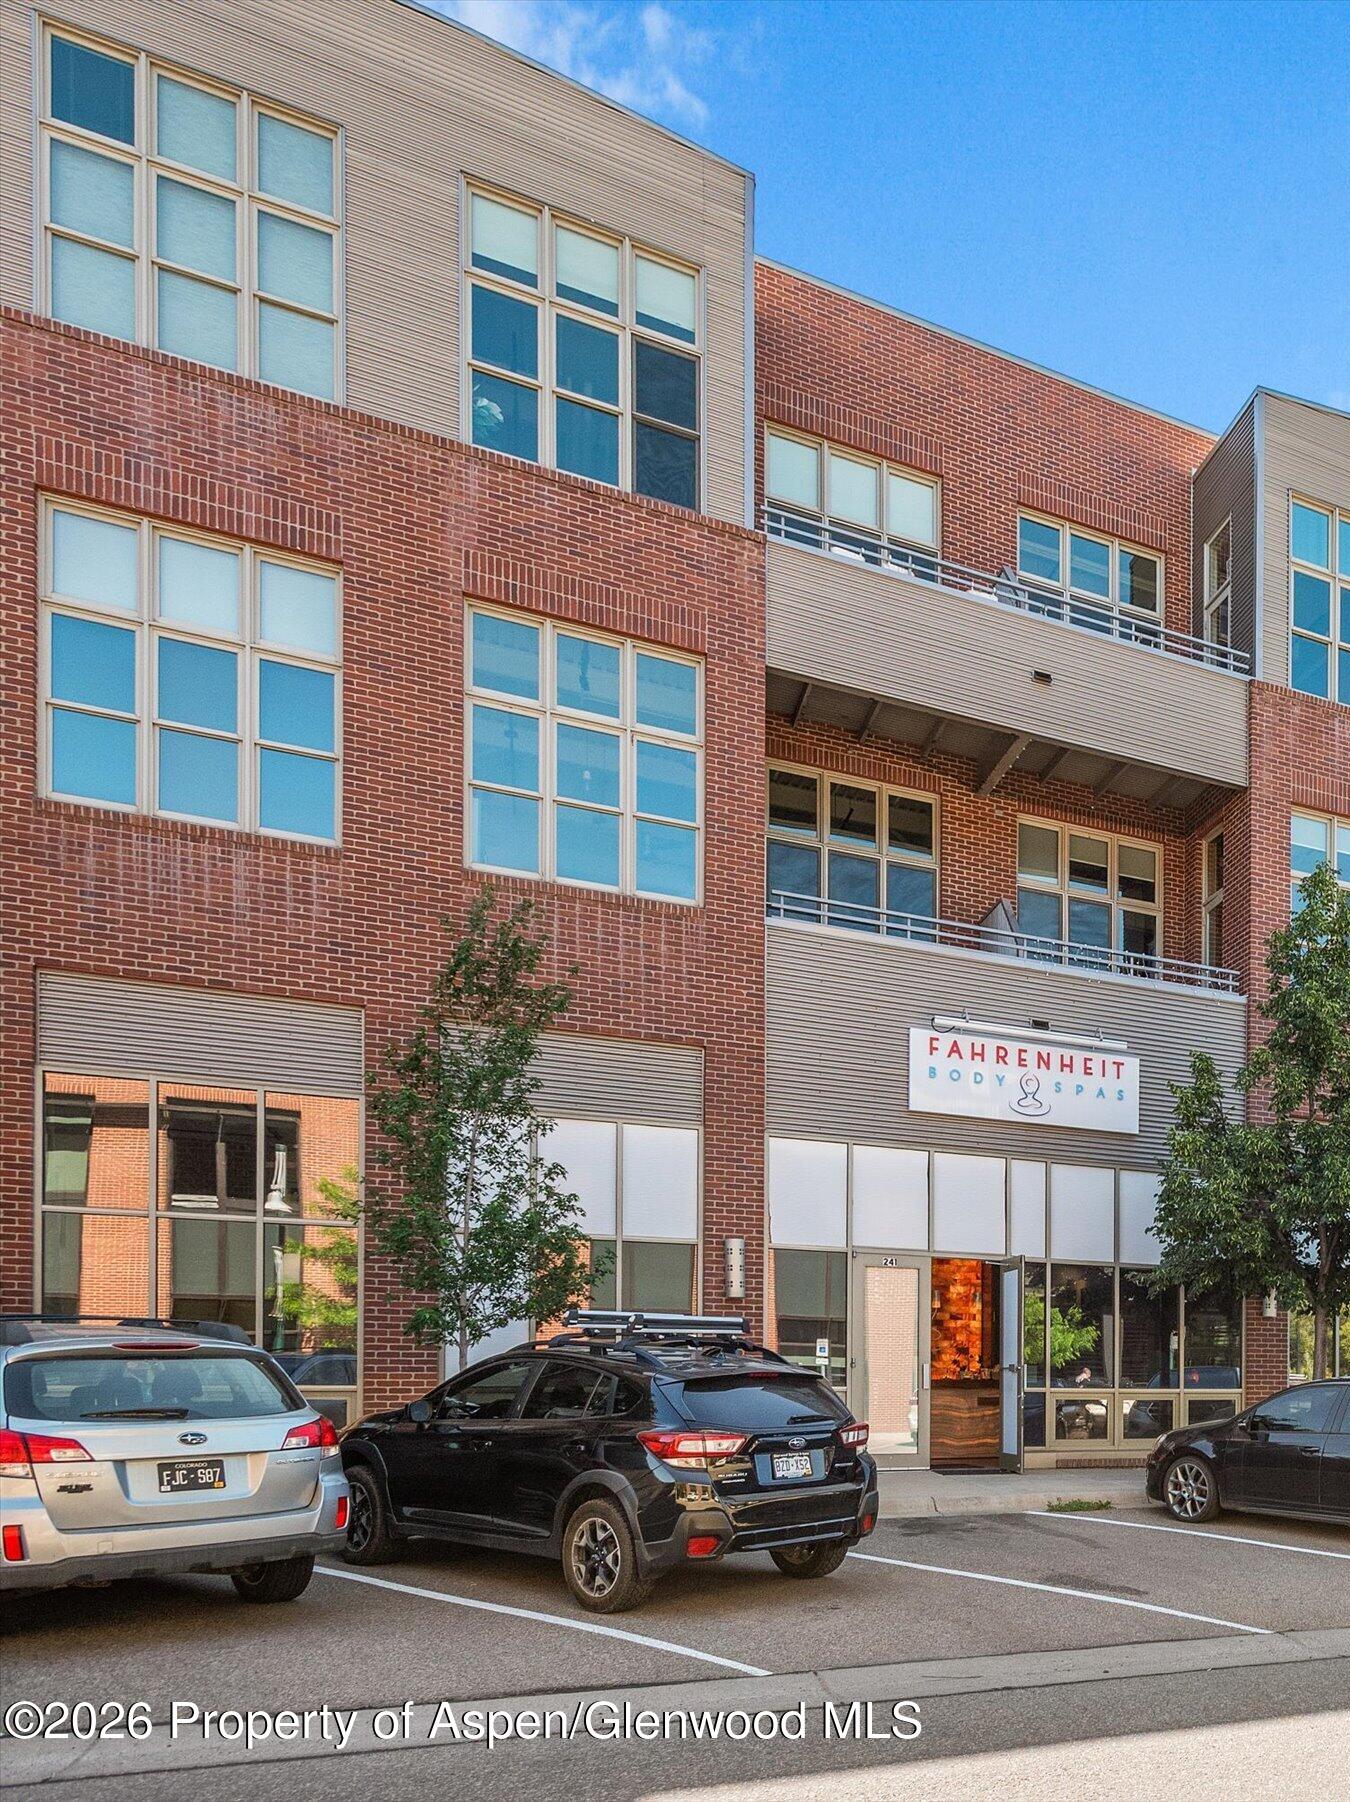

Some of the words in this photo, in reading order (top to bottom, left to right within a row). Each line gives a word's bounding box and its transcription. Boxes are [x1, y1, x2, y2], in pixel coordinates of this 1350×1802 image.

[928, 1036, 1125, 1080] FAHRENHEIT
[928, 1066, 1006, 1087] BODY
[1054, 1081, 1125, 1101] SPAS
[883, 1257, 898, 1266] 241
